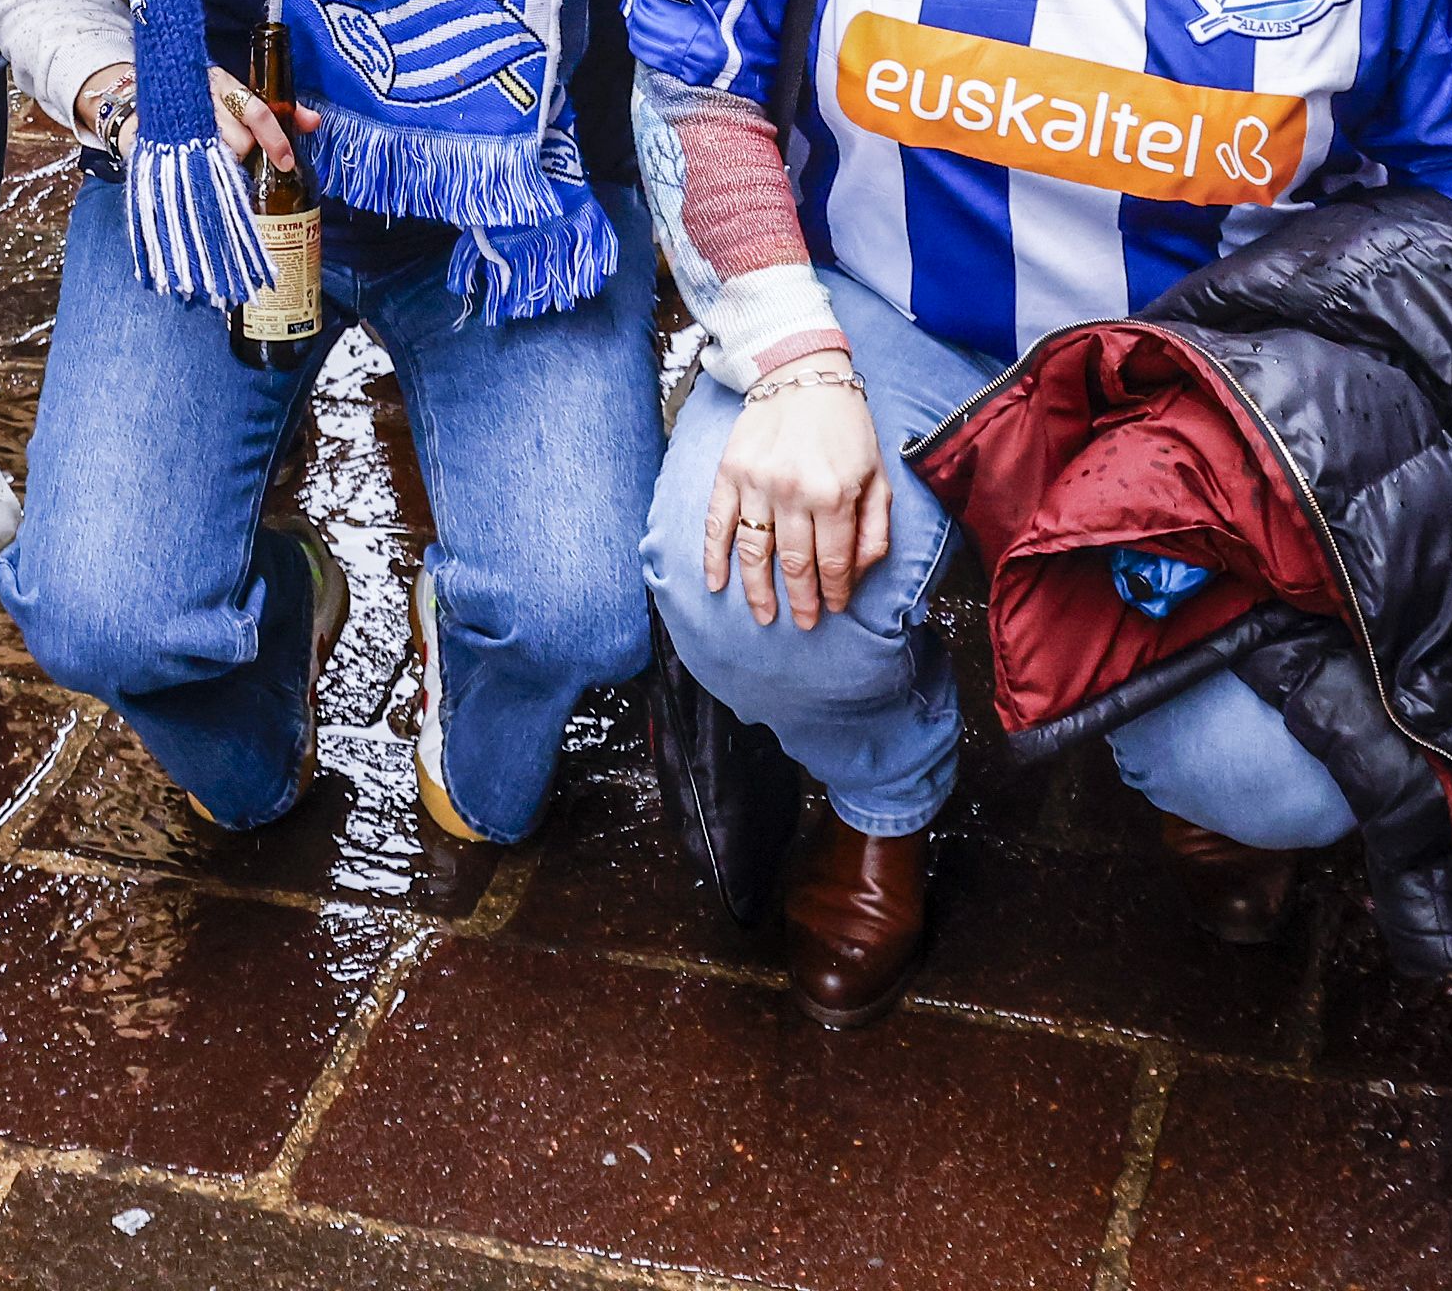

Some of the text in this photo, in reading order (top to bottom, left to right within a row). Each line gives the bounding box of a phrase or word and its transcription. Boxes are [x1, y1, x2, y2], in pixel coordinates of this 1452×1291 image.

[1238, 19, 1293, 33] ALAVES
[864, 57, 1204, 178] euskaltel
[277, 221, 304, 232] EXTRA
